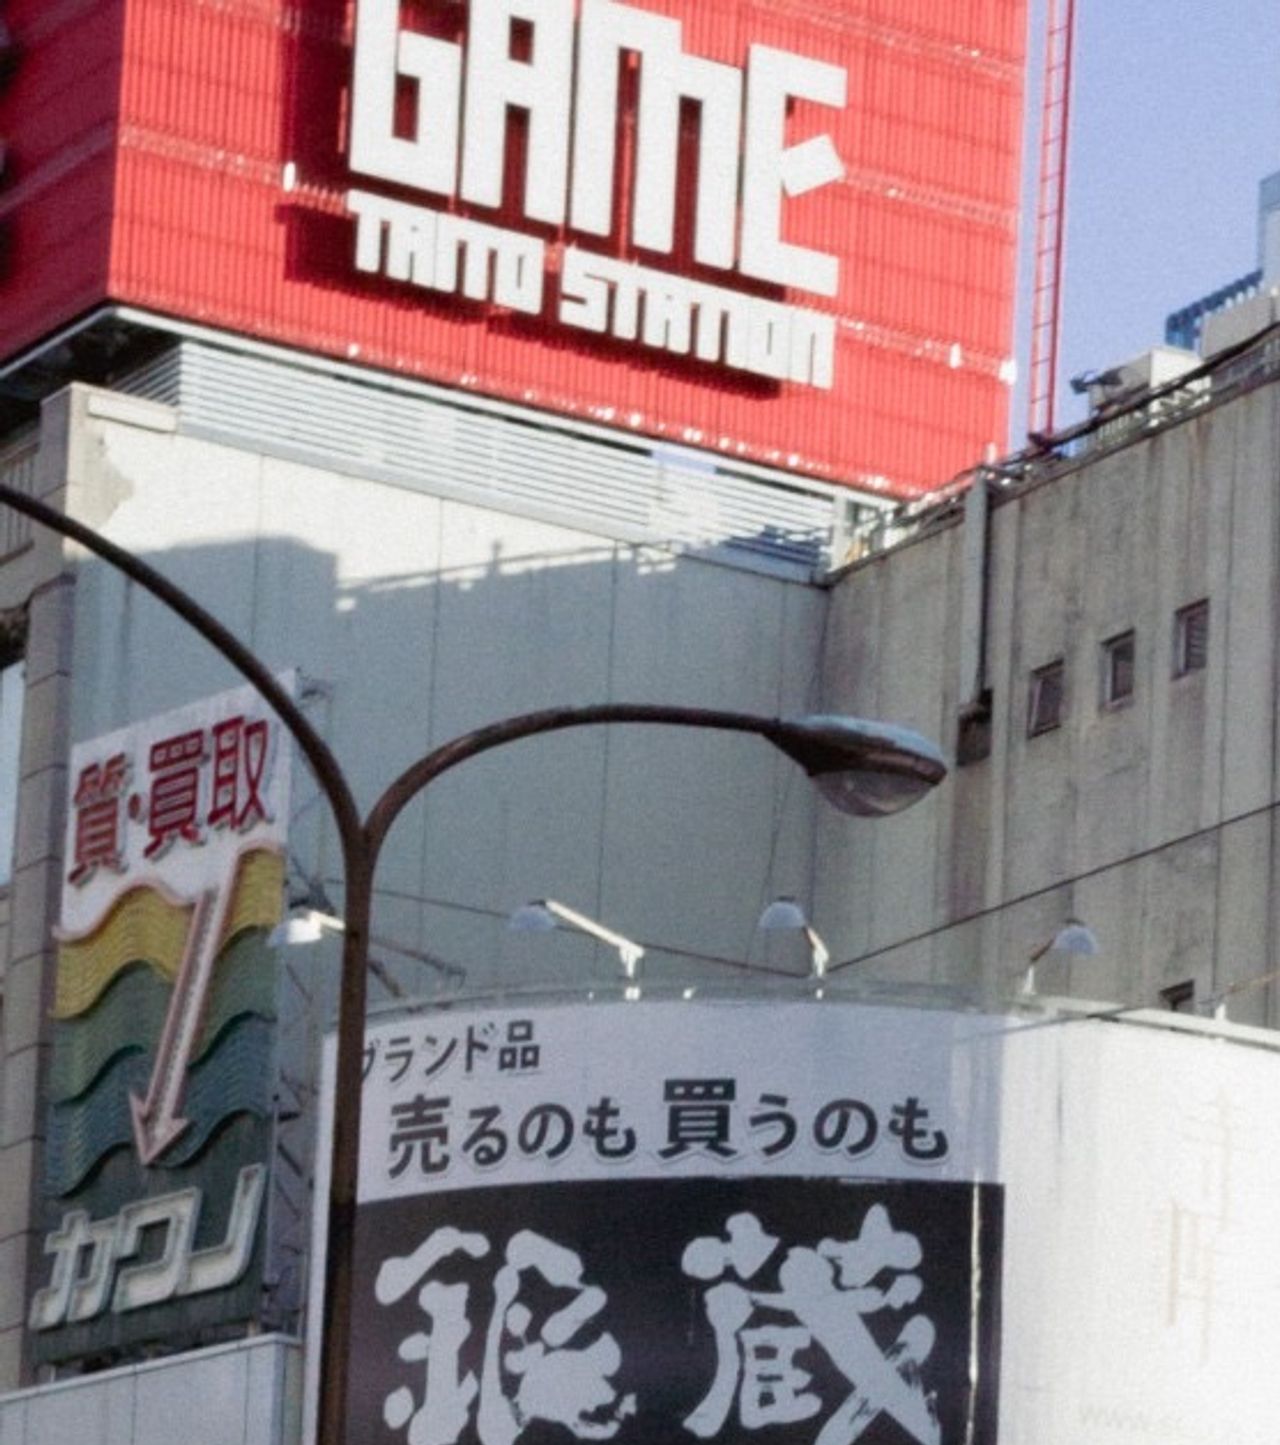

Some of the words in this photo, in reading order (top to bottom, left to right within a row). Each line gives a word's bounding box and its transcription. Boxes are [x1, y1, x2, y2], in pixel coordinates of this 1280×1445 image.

[349, 0, 847, 297] GAME
[347, 189, 545, 315] TAITO
[558, 245, 836, 391] STATION
[67, 714, 270, 884] 質・買取
[28, 1163, 265, 1331] カワノ
